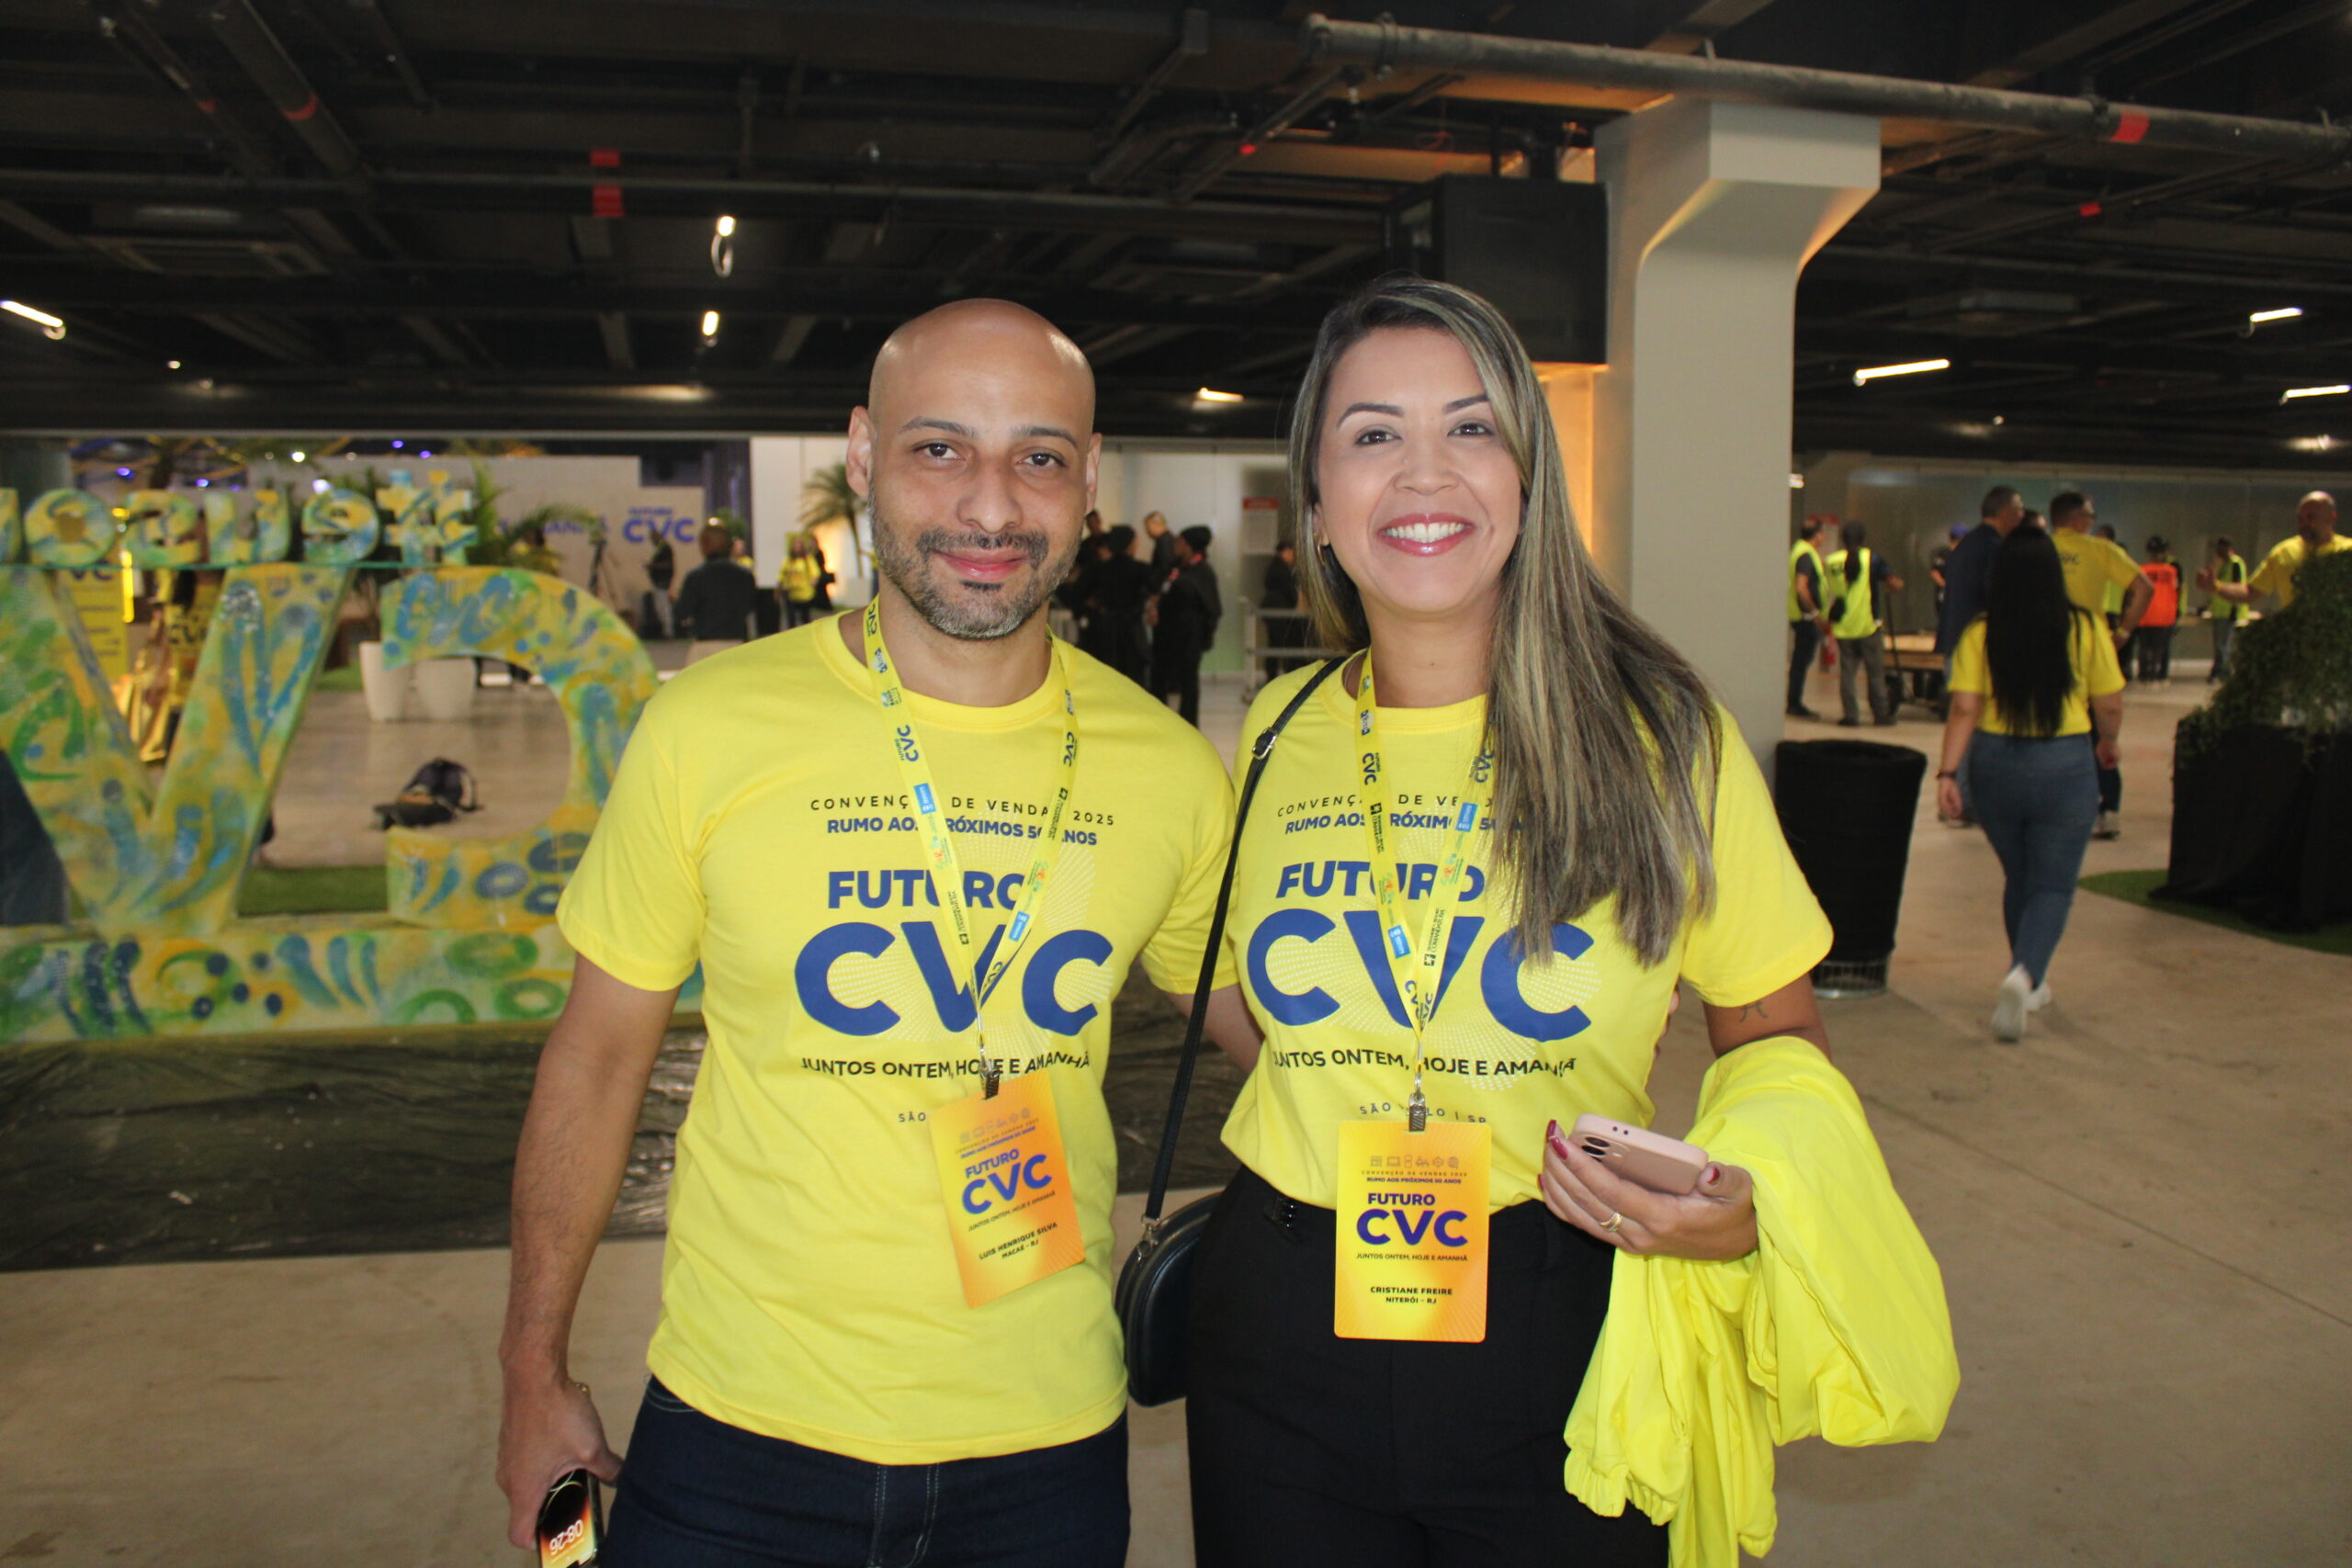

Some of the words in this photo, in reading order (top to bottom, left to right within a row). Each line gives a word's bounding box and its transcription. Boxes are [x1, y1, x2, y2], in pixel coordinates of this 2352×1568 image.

[623, 518, 695, 542] CVC
[897, 725, 919, 762] CVC
[1362, 752, 1377, 785] CVC
[810, 795, 910, 811] CONVENÇ
[952, 796, 975, 808] DE
[987, 799, 1048, 817] VENDA
[1073, 810, 1114, 826] 2025
[1277, 794, 1363, 817] CONVENÇ
[1398, 794, 1423, 805] DE
[827, 817, 884, 834] RUMO
[888, 817, 918, 831] AO
[945, 815, 1023, 838] RÓXIMOS
[1061, 829, 1097, 846] NOS
[1285, 814, 1331, 835] RUMO
[1389, 810, 1453, 829] RÓXIM
[794, 921, 1114, 1037] CVC
[1247, 908, 1595, 1043] CVC
[801, 1057, 876, 1077] JUNTOS
[882, 1060, 955, 1079] ONTEM,
[956, 1058, 1004, 1076] HOE
[1009, 1058, 1021, 1074] E
[1024, 1051, 1091, 1075] AMANHÃ
[1331, 1049, 1409, 1070] ONTEM,
[1476, 1060, 1488, 1076] E
[898, 1111, 927, 1123] SÃO
[1359, 1102, 1391, 1115] SÃO
[965, 1148, 1020, 1179] FUTURO
[961, 1154, 1053, 1214] CVC
[1367, 1192, 1436, 1206] FUTURO
[978, 1247, 997, 1259] LUIS
[998, 1230, 1035, 1251] HENRIQUE
[1036, 1222, 1057, 1235] SILVA
[1356, 1208, 1468, 1247] CVC
[1370, 1286, 1419, 1294] CRISTIANE
